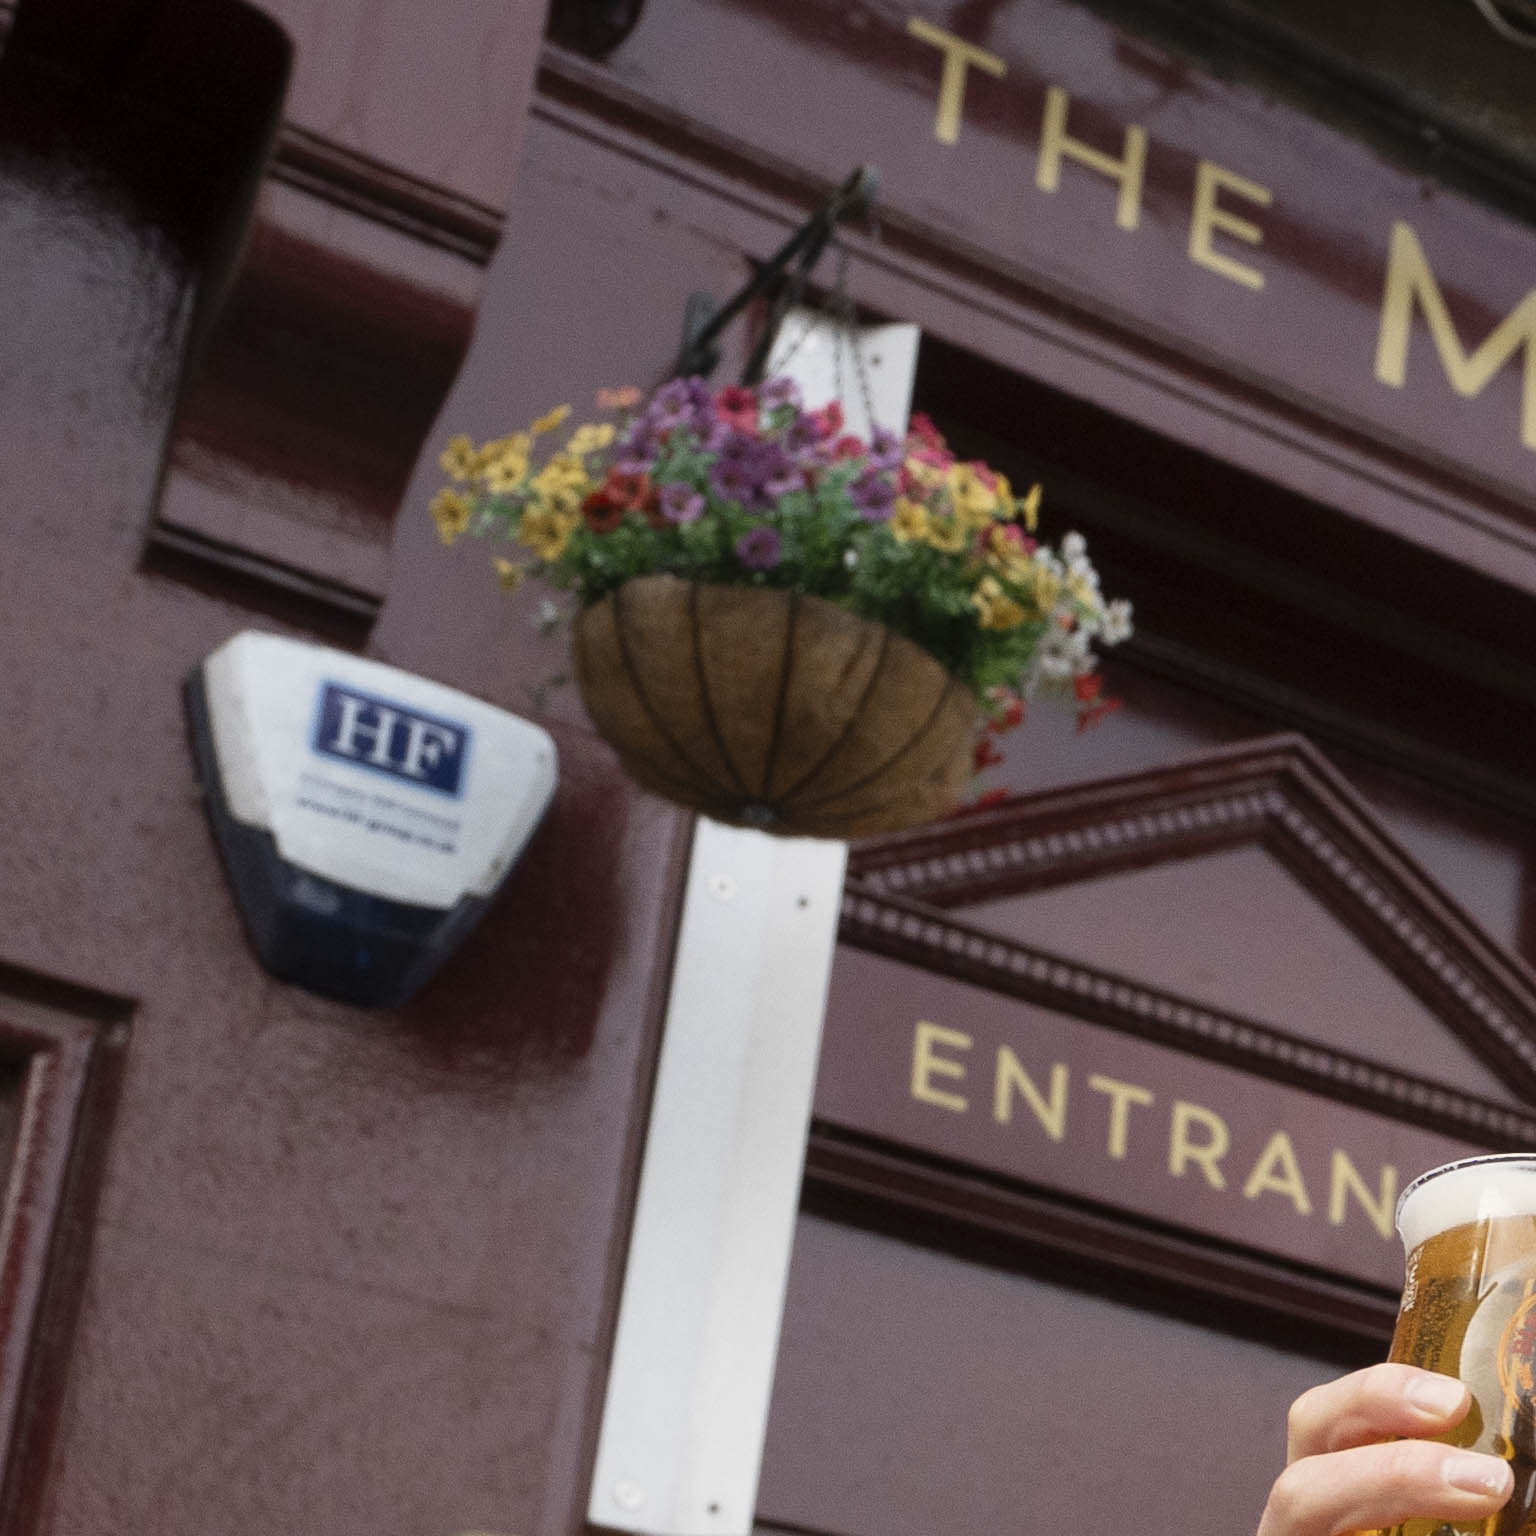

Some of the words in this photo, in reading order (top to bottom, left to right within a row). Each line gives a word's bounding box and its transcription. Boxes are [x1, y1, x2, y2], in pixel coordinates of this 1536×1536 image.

[906, 18, 1272, 290] THE
[331, 694, 459, 779] HF
[908, 1020, 1397, 1241] ENTRAN
